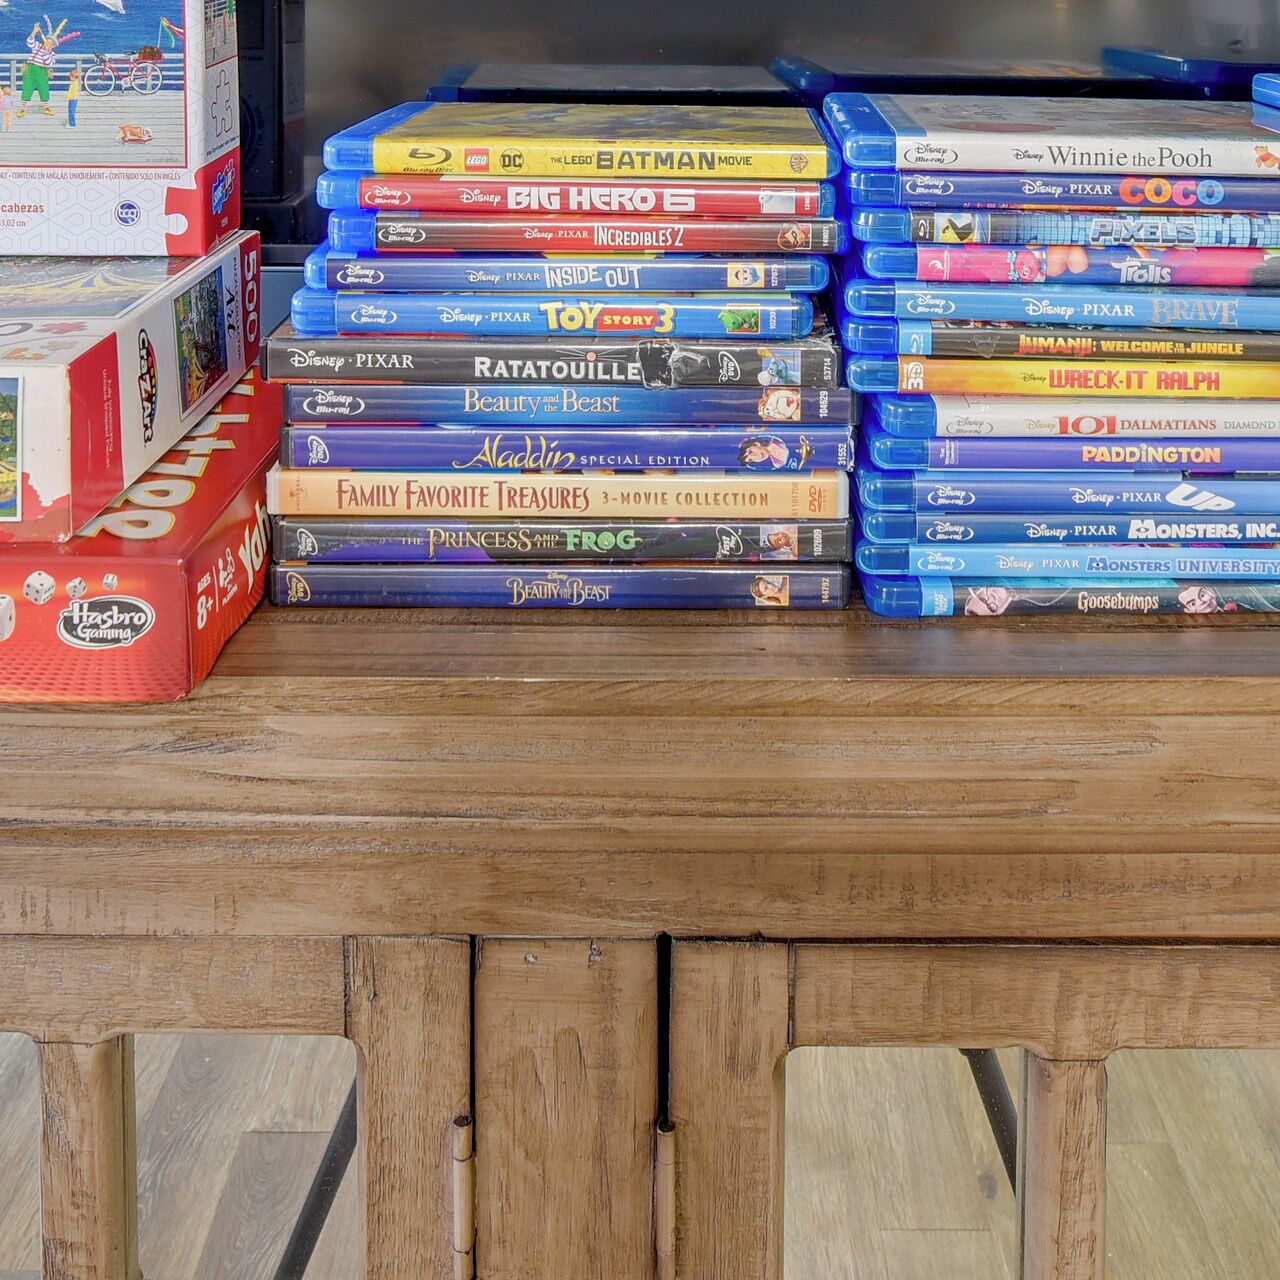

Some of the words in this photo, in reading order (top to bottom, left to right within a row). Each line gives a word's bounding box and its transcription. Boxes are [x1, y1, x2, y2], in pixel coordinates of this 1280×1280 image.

[467, 155, 487, 165] LEGO
[501, 153, 522, 168] DC
[564, 155, 592, 165] LEGO
[596, 151, 716, 170] BATMAN
[718, 156, 752, 166] MOVIE
[1048, 146, 1128, 167] Winnie
[1132, 151, 1156, 167] the
[1157, 147, 1212, 168] Pooh
[507, 186, 560, 209] BIG
[570, 187, 656, 211] HERO
[663, 189, 695, 211] 6
[1022, 180, 1063, 198] Disney
[1070, 184, 1112, 195] PIXAR
[1120, 176, 1224, 205] COCO
[594, 225, 673, 246] INCREDIBLES
[674, 227, 684, 247] 2
[1089, 219, 1197, 244] PIXELS
[545, 265, 602, 288] INSIDE
[605, 266, 642, 289] OUT
[1111, 261, 1172, 284] Trolls
[244, 250, 257, 343] 500
[603, 315, 654, 325] STORY
[654, 302, 675, 333] 3
[1022, 297, 1075, 319] Disney
[1083, 304, 1135, 316] PIXAR
[1151, 299, 1239, 328] BRAVE
[1101, 341, 1174, 353] WELCOME
[1186, 342, 1243, 354] JUNGLE
[287, 348, 345, 372] Disney
[356, 354, 414, 368] PIXAR
[474, 356, 641, 381] RATATOUILLE
[823, 358, 832, 381] 53714
[1048, 369, 1148, 389] WRECK-IT
[1156, 371, 1221, 392] RALPH
[463, 388, 542, 418] Beauty
[543, 394, 559, 403] and
[544, 404, 559, 412] the
[561, 389, 621, 413] Beast
[820, 390, 828, 418] 104629
[1055, 415, 1120, 435] 101
[1121, 419, 1217, 431] DALMATIANS
[1223, 420, 1275, 430] DIAMOND
[452, 434, 576, 469] Aladdin
[581, 453, 641, 466] SPECIAL
[649, 454, 710, 466] EDITION
[838, 443, 847, 466] 31552
[336, 479, 399, 510] FAMILY
[405, 479, 489, 510] FAVORITE
[493, 480, 590, 513] TREASURES
[602, 491, 668, 506] 3-MOVIE
[675, 492, 768, 506] COLLECTION
[1166, 483, 1236, 511] UP
[560, 529, 643, 553] FROG
[1127, 519, 1242, 539] MONSTERS,
[402, 537, 423, 545] THE
[426, 528, 532, 559] PRINCESS
[813, 529, 822, 556] 102609
[1086, 557, 1171, 572] MONSTERS
[506, 577, 559, 605] BEAUTY
[567, 578, 612, 605] BEAST
[1077, 591, 1159, 613] Goosebumps
[62, 602, 146, 627] Hasbro
[197, 594, 213, 630] 8+
[77, 623, 132, 641] Gaming
